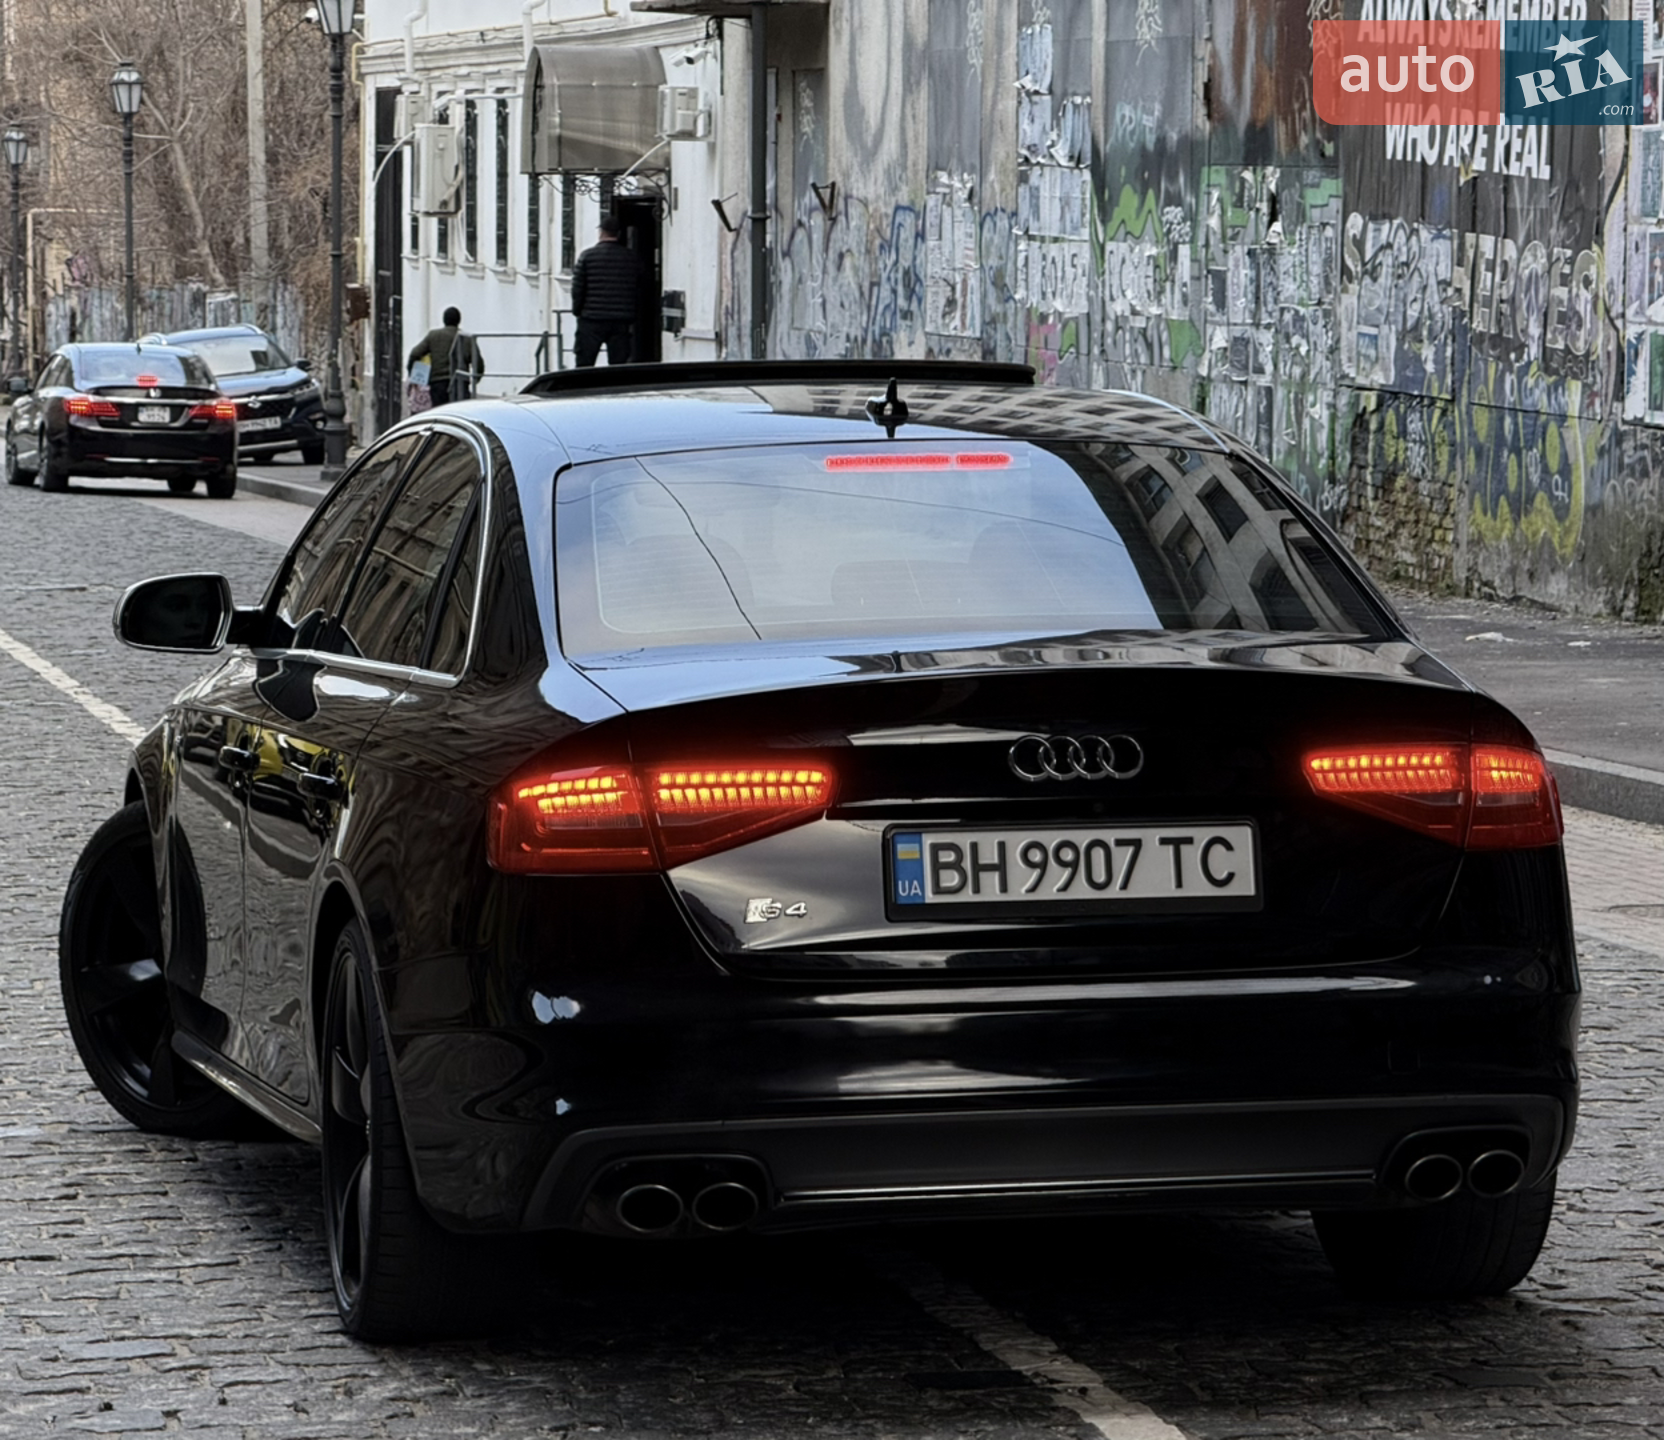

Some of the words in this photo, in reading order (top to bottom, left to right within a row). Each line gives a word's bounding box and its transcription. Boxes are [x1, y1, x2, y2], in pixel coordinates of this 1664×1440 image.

[1357, 0, 1453, 47] ALWAYS
[1385, 102, 1441, 166] WHO
[1443, 106, 1490, 171] ARE
[1492, 112, 1551, 180] REAL
[898, 879, 923, 897] UA
[929, 840, 1007, 896] BH
[1018, 837, 1143, 893] 9907
[1157, 836, 1236, 890] TC
[757, 900, 808, 919] S4
